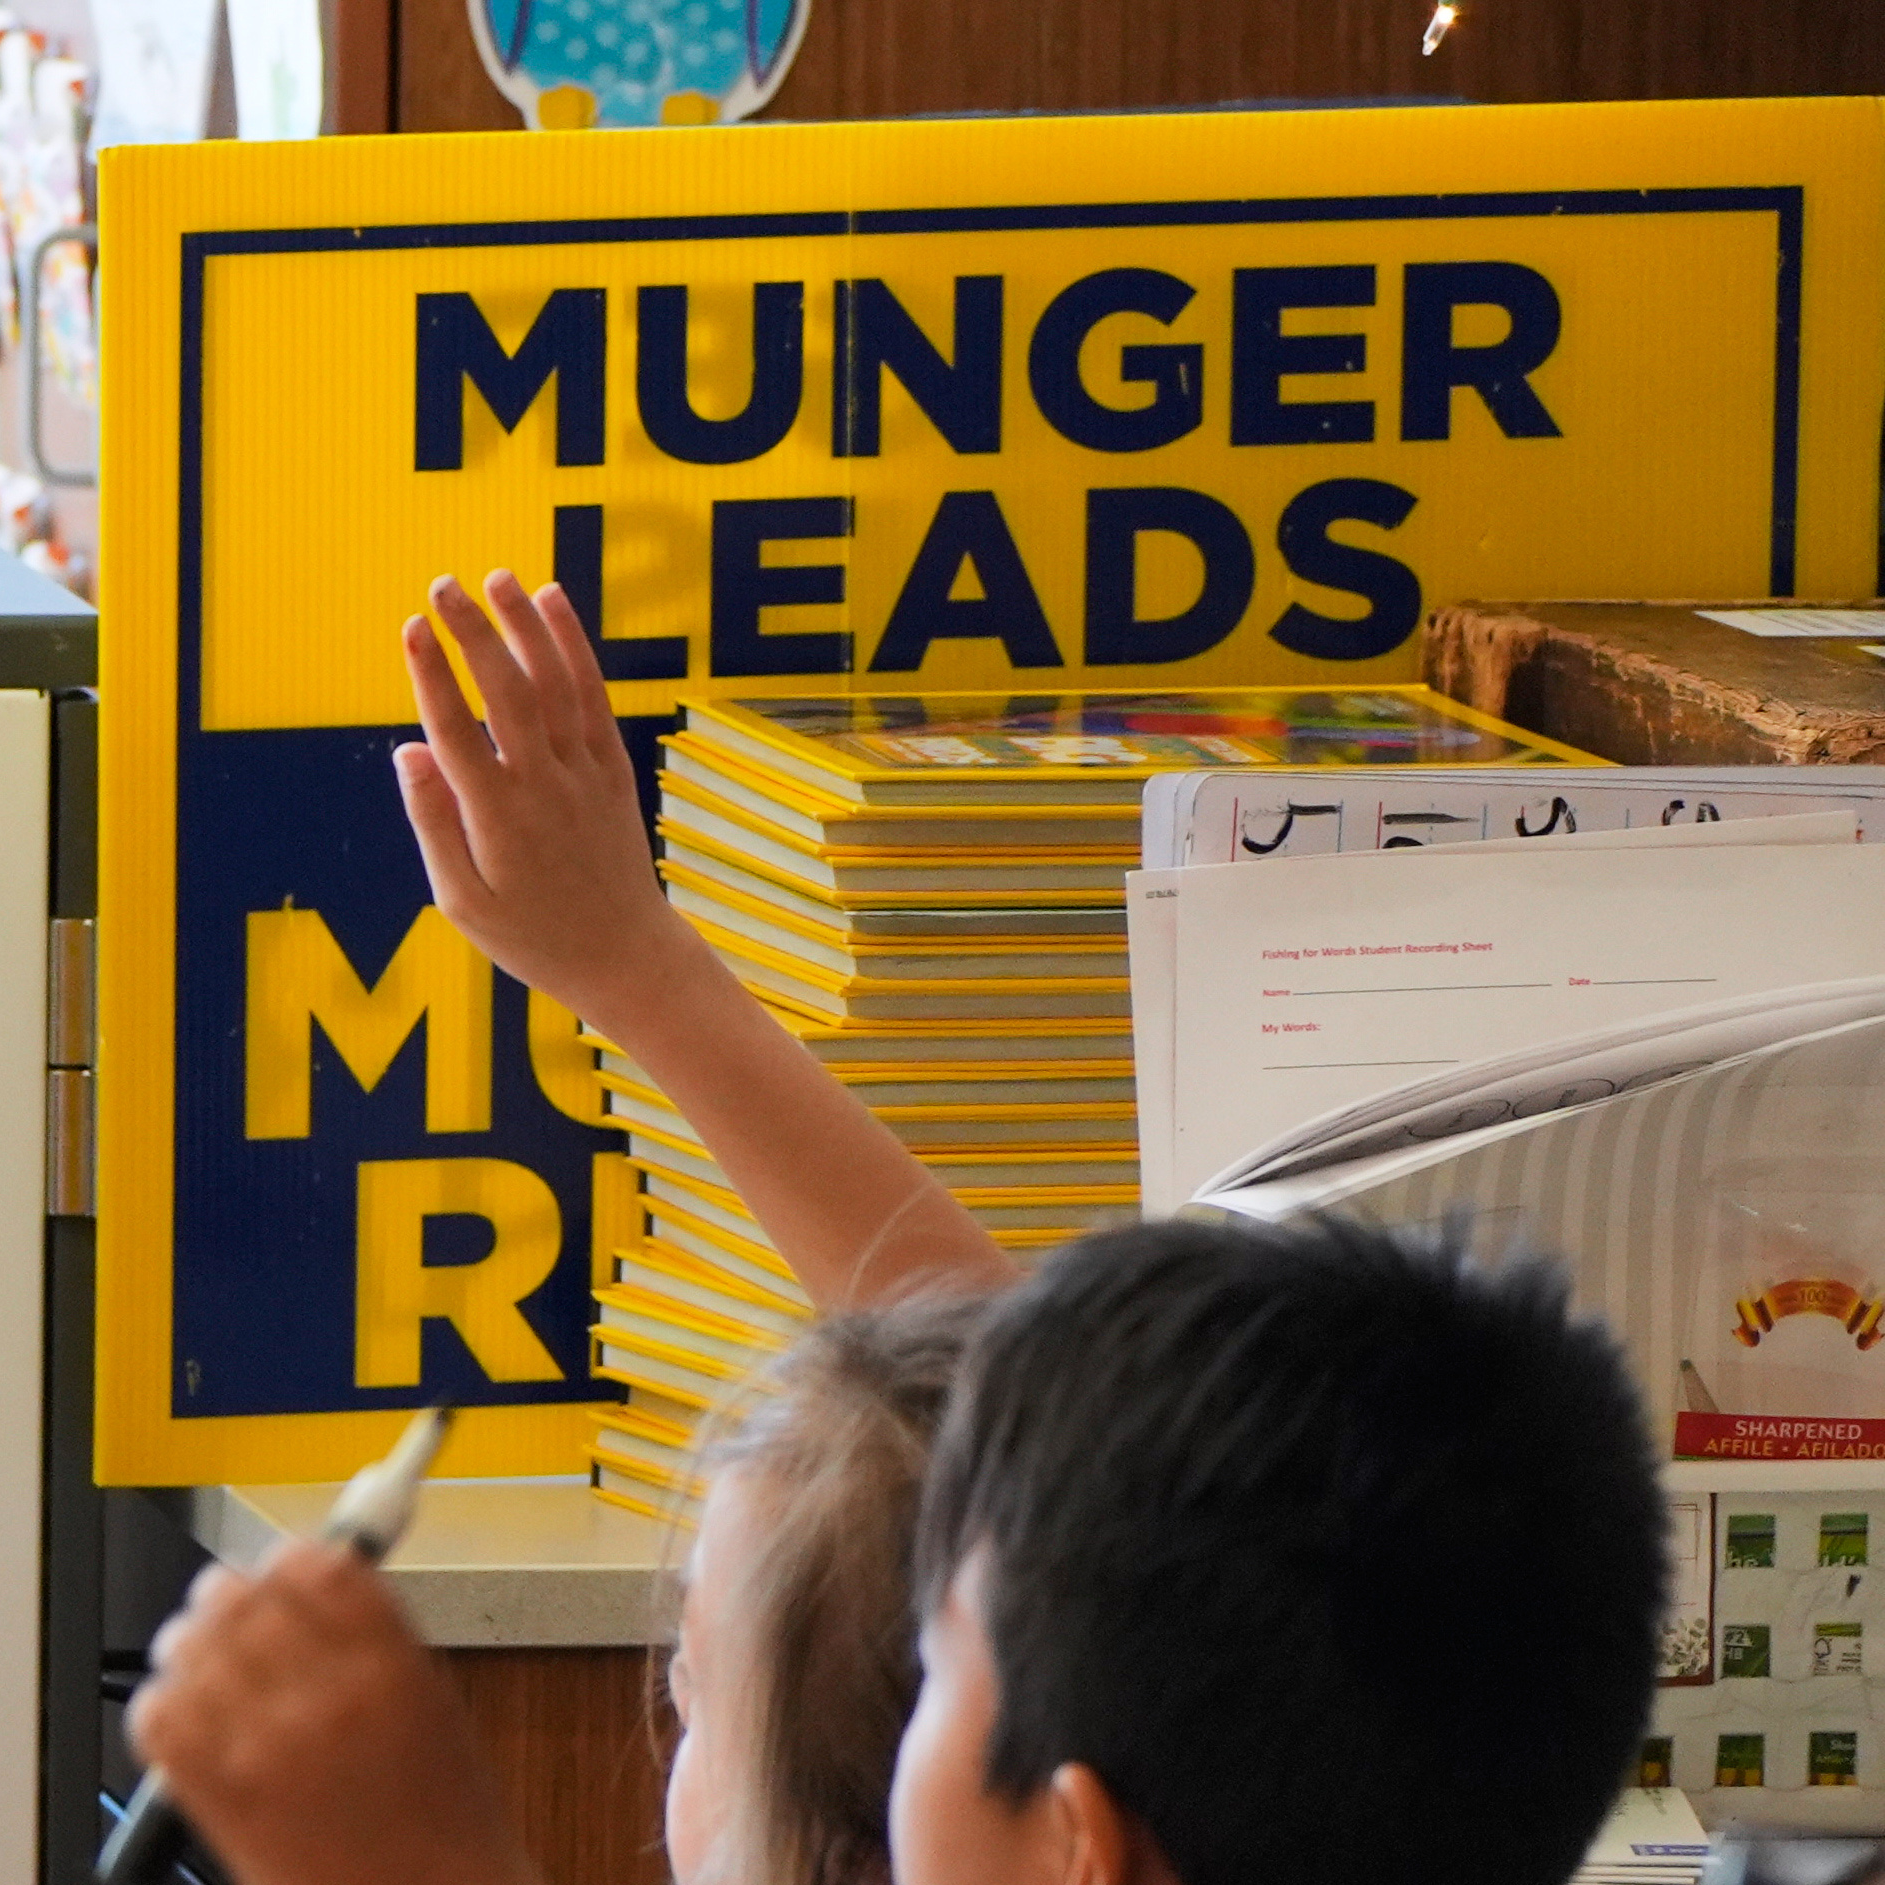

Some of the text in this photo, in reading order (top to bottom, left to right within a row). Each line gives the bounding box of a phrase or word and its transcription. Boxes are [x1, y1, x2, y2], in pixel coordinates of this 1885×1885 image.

[412, 260, 1564, 472] MUNGER
[552, 478, 1422, 681] LEADS
[1262, 942, 1493, 961] Fishing for Words Student Recording Sheet
[245, 905, 616, 1140] M
[1262, 1022, 1321, 1035] My Words:
[1734, 1420, 1863, 1440] SHARPENED
[1704, 1437, 1774, 1457] AFFILE
